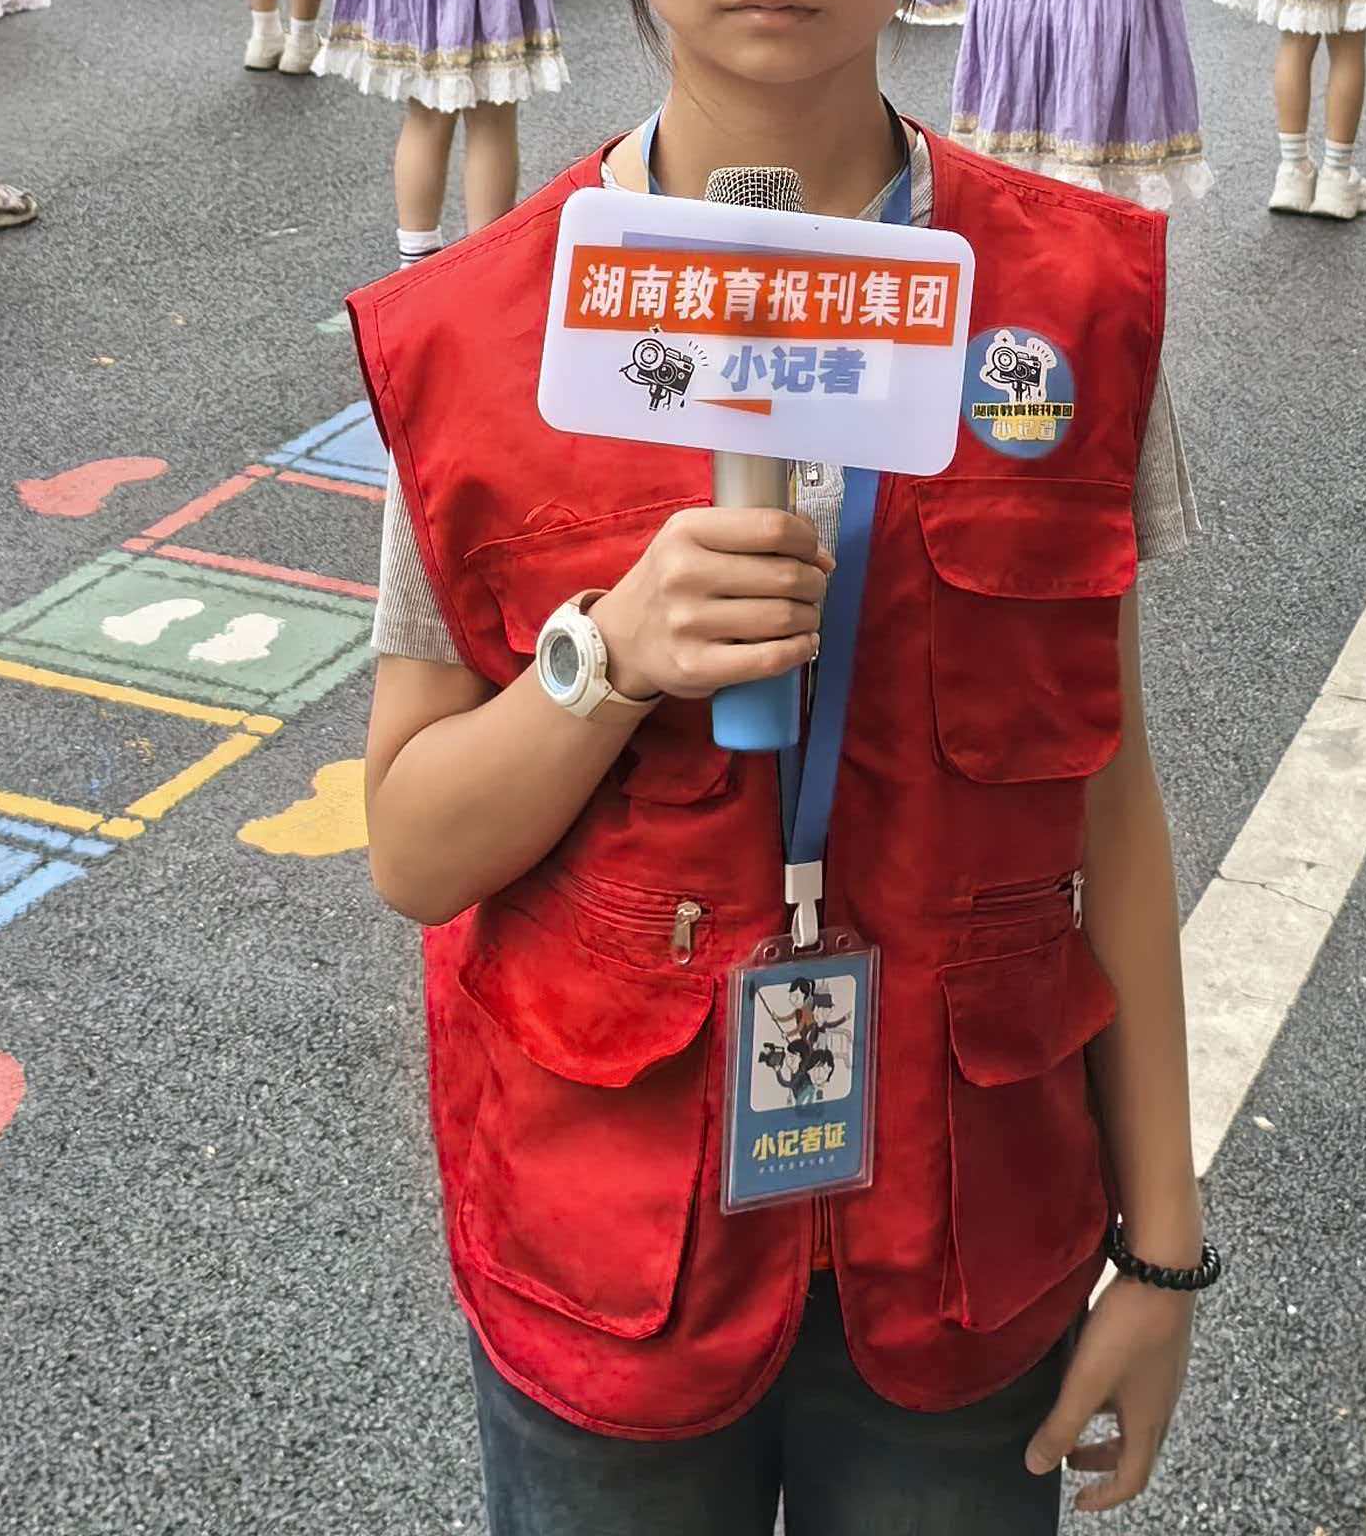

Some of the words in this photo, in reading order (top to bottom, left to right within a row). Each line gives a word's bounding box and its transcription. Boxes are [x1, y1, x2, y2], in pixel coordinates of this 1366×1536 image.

[579, 263, 950, 329] 湖南教育报刊集团
[720, 344, 867, 395] 小记者
[752, 1122, 847, 1161] 小记者证
